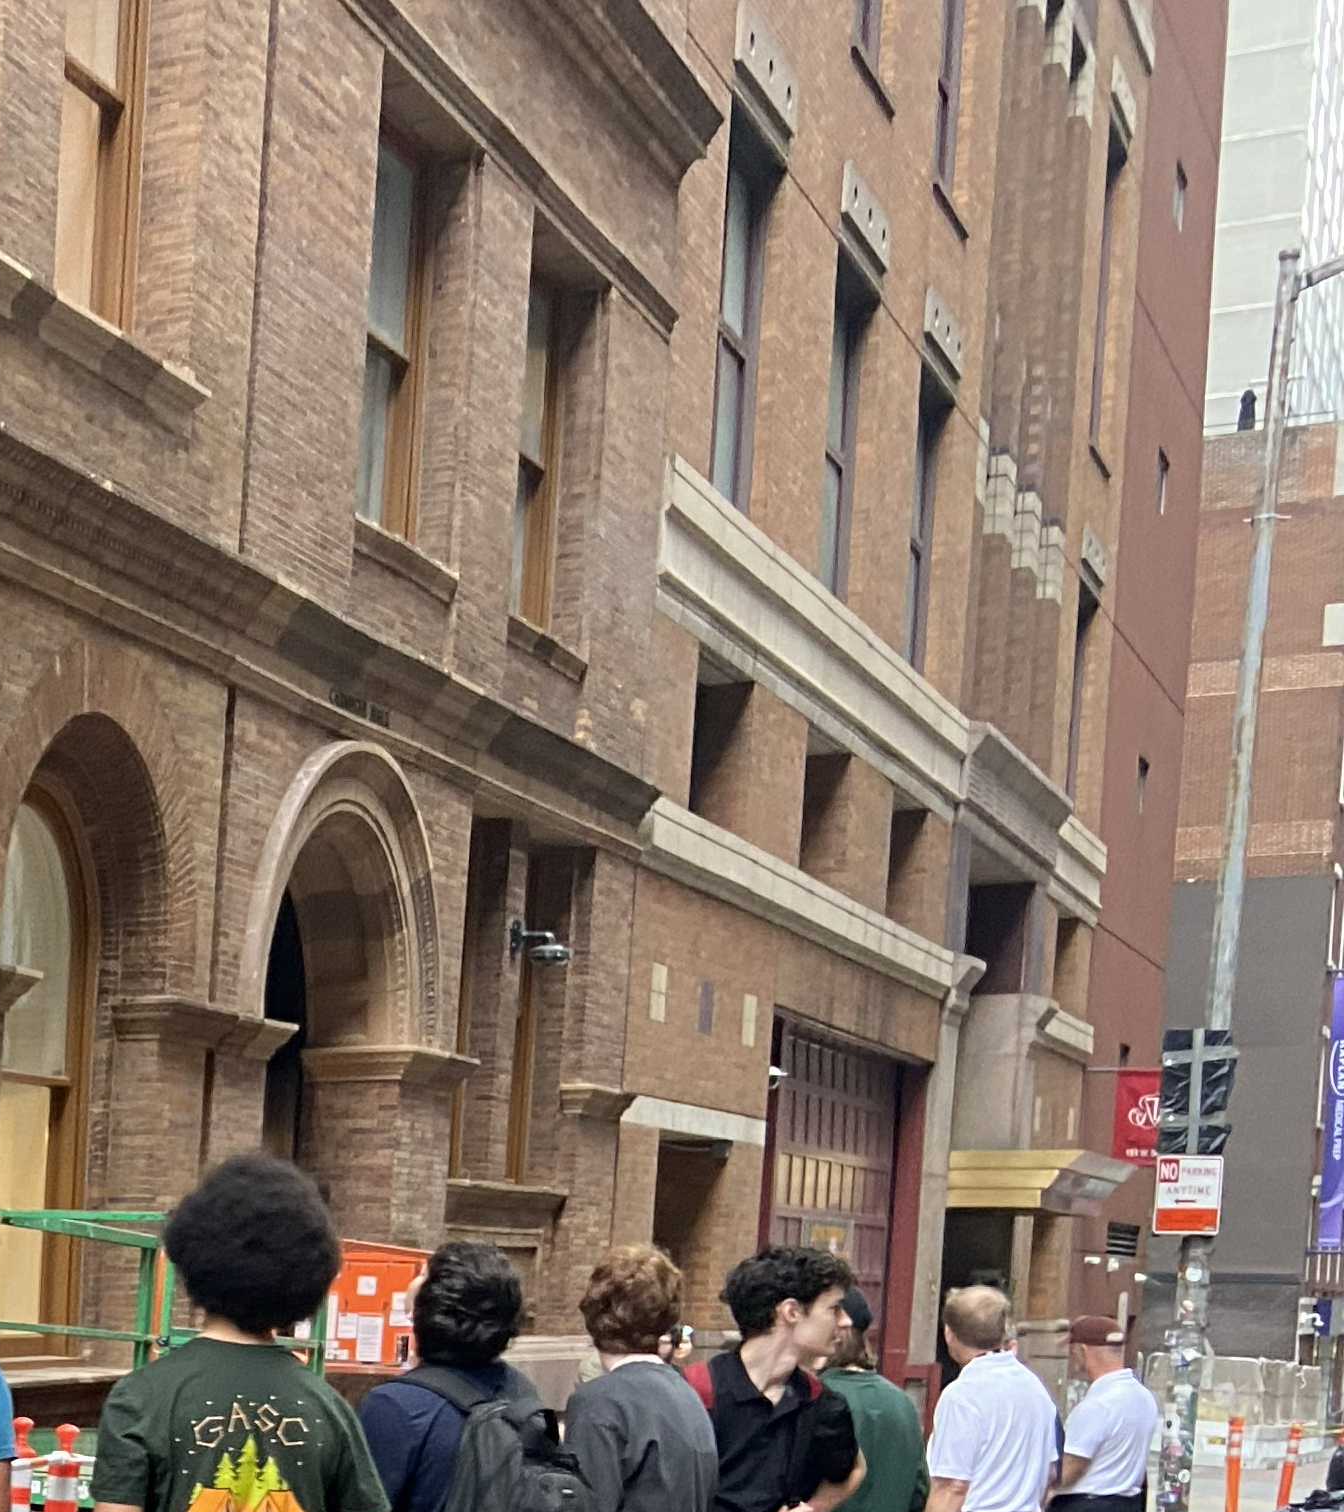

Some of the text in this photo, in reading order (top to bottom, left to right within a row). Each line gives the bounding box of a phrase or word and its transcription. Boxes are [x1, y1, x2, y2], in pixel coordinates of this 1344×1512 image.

[1160, 1162, 1218, 1180] NO PARKING
[1166, 1185, 1212, 1197] ANYTIME
[193, 1401, 310, 1449] GASC
